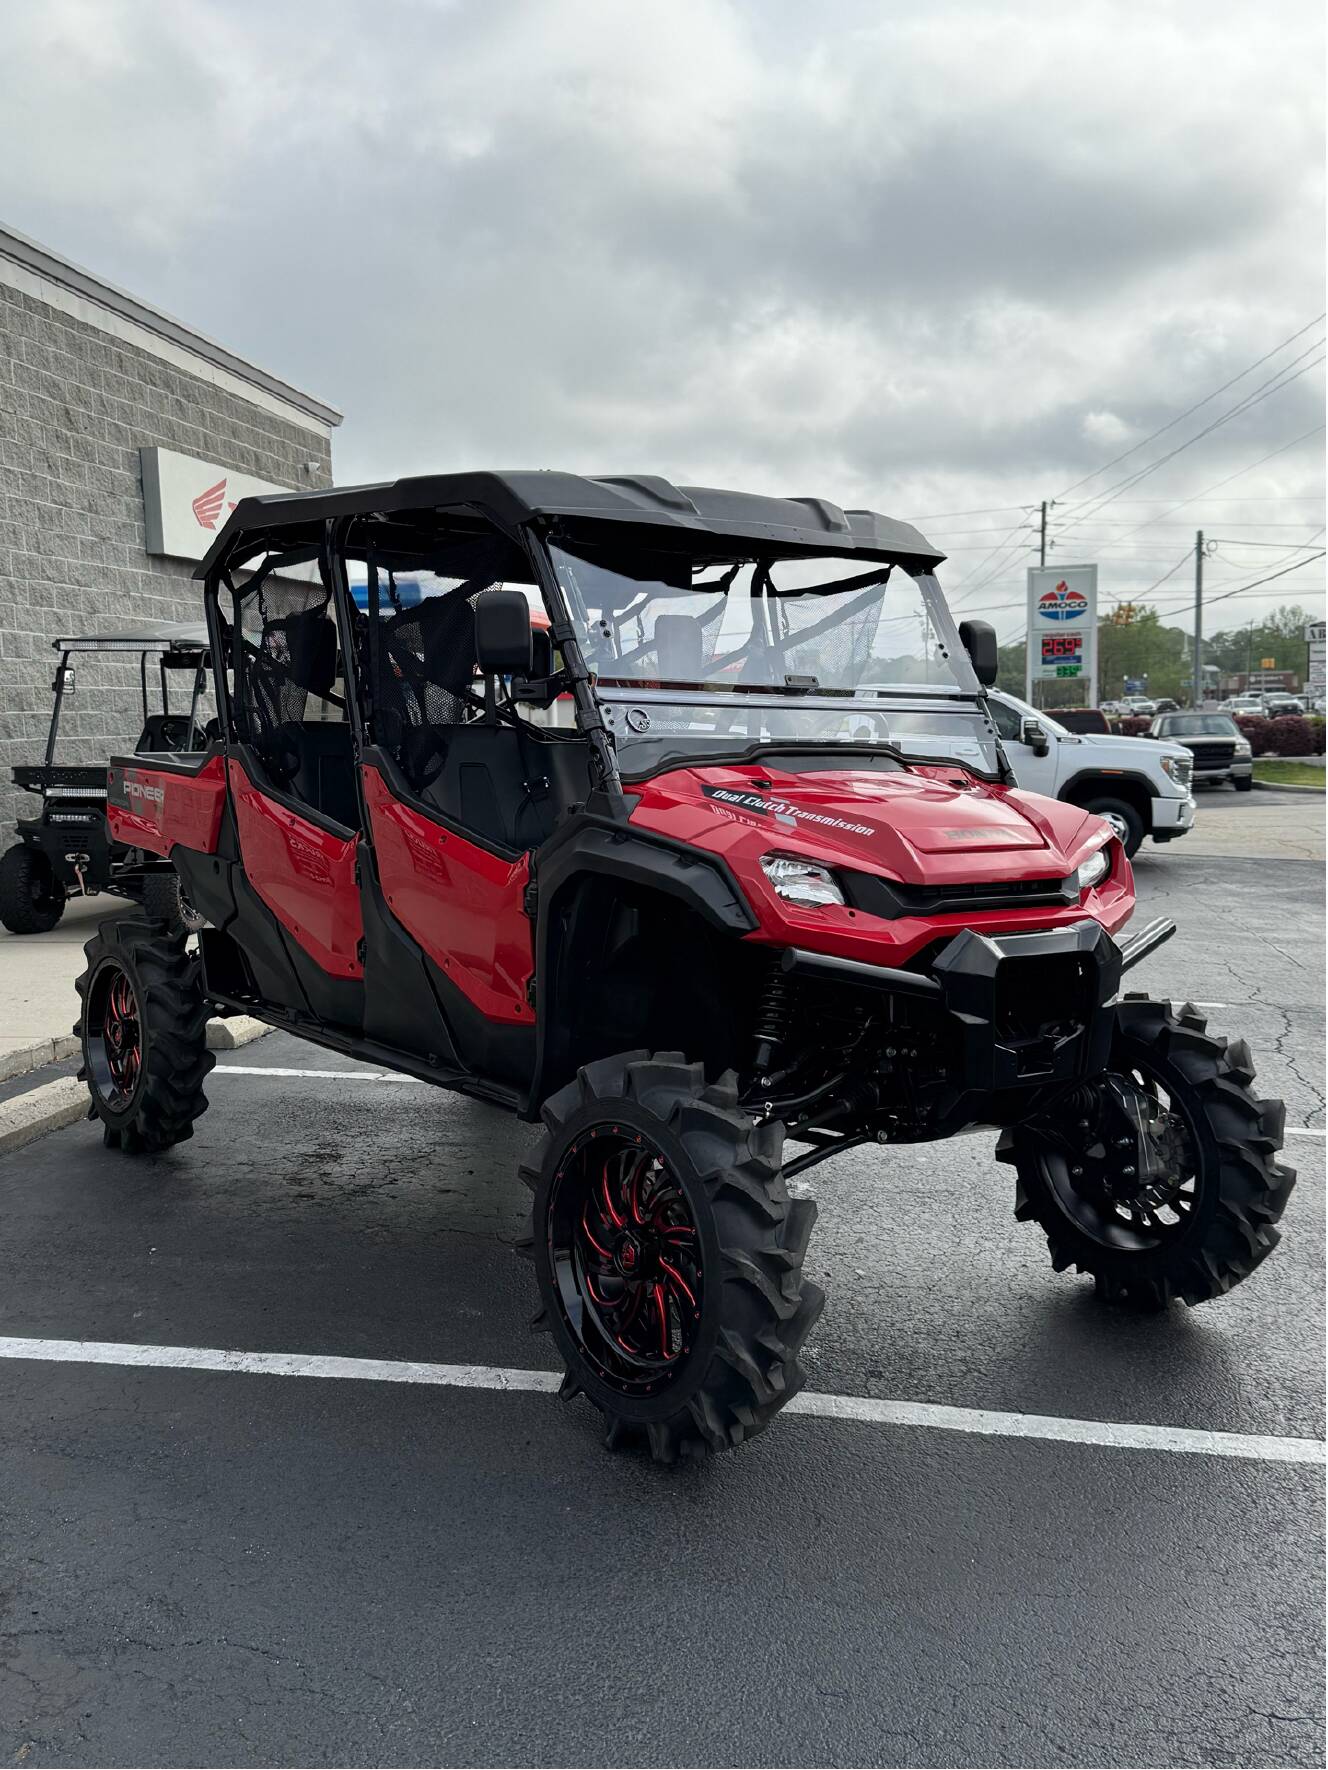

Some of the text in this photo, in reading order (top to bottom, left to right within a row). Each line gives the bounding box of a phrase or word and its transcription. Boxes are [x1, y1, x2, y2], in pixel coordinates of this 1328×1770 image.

[1038, 600, 1088, 610] AMOCO
[711, 789, 741, 804] Dual
[743, 793, 784, 814] Clutch
[782, 805, 876, 837] Transmission
